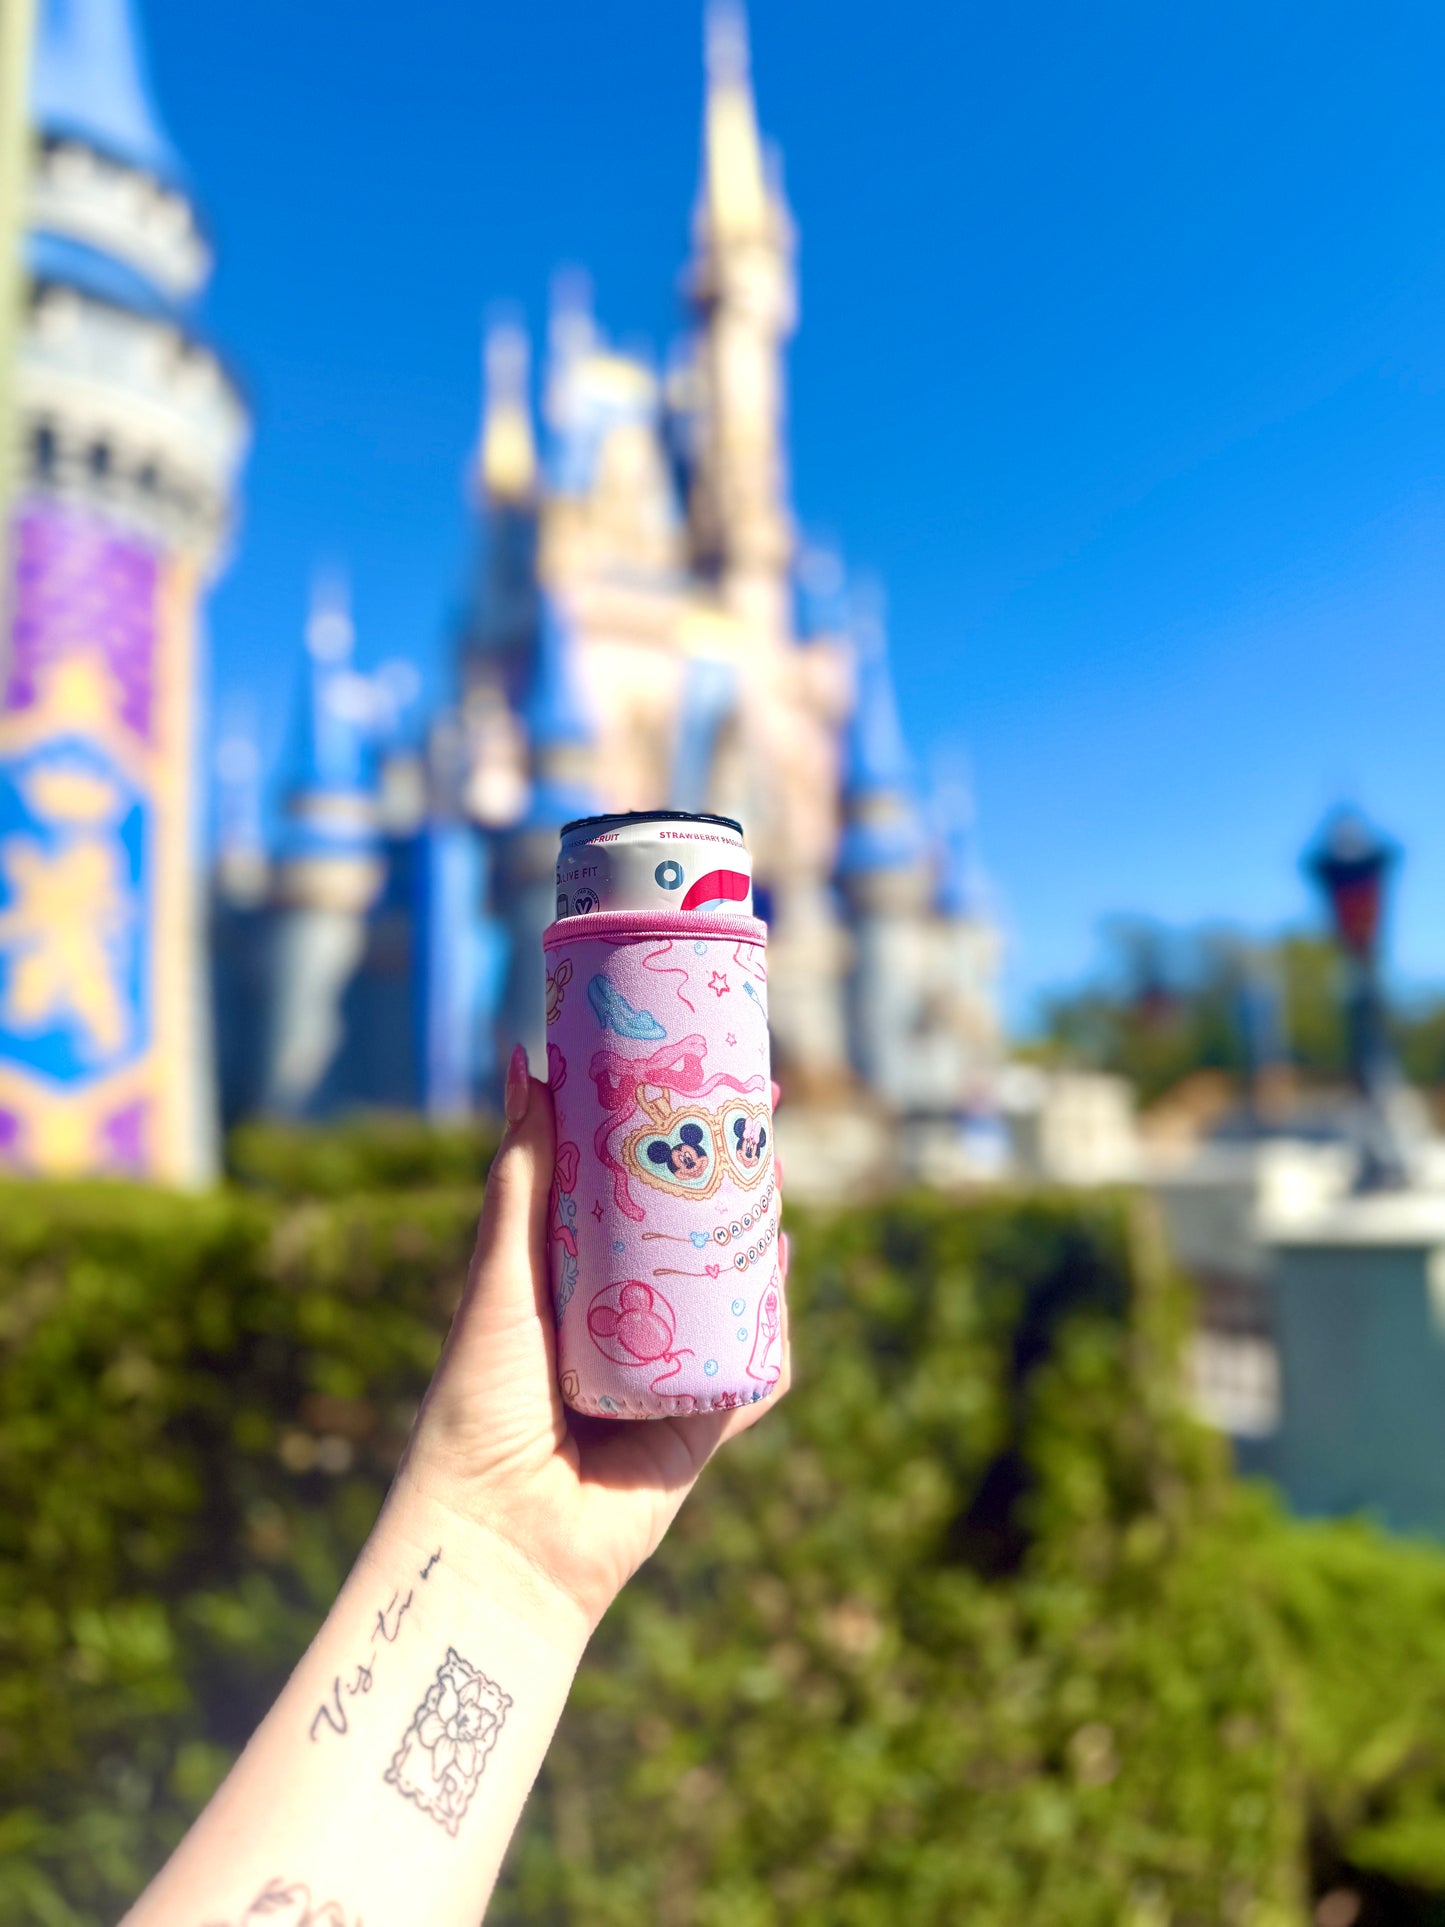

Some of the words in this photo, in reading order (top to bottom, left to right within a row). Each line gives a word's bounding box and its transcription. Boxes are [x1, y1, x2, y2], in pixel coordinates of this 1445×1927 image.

[659, 831, 720, 843] STRAWBERRY
[562, 868, 581, 884] LIVE
[583, 866, 598, 878] FIT
